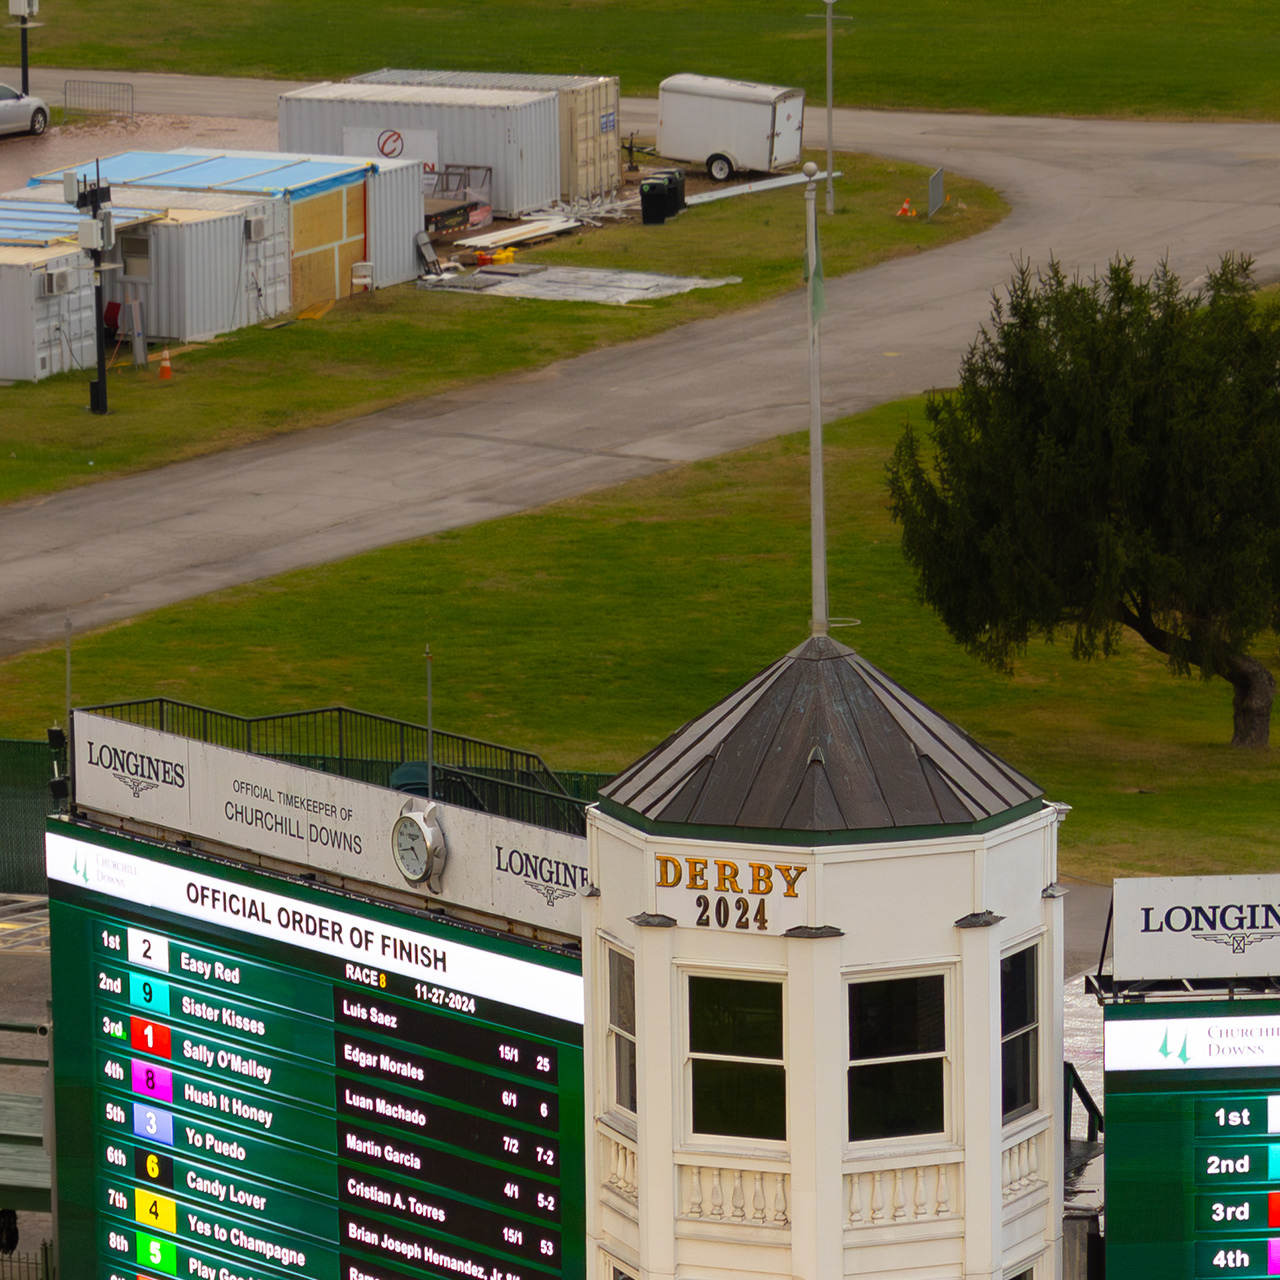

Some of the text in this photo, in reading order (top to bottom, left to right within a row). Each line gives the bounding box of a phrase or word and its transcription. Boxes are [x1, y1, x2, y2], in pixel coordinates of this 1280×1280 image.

[87, 741, 185, 788] LONGINES
[233, 779, 353, 822] OFFICIAL TIMEKEEPER OF
[224, 801, 363, 855] CHURCHILL DOWNS
[495, 845, 589, 890] LONGINE
[656, 854, 807, 898] DERBY
[186, 882, 447, 973] OFFICIAL ORDER OF FINISH
[695, 895, 768, 931] 2024
[180, 951, 240, 985] Easy Red
[345, 963, 476, 1014] RACE 8 11-27-2024
[182, 995, 265, 1036] Sister Kisses
[183, 1039, 272, 1085] Sally O'Malley
[184, 1083, 273, 1129] Hush It Honey
[1214, 1107, 1251, 1126] 1st
[185, 1126, 246, 1161] Yo Puedo
[1207, 1154, 1250, 1174] 2nd
[186, 1170, 267, 1211] Candy Lover
[1211, 1201, 1250, 1222] 3rd
[187, 1213, 306, 1267] Yes to Champagne
[1212, 1249, 1250, 1268] 4th
